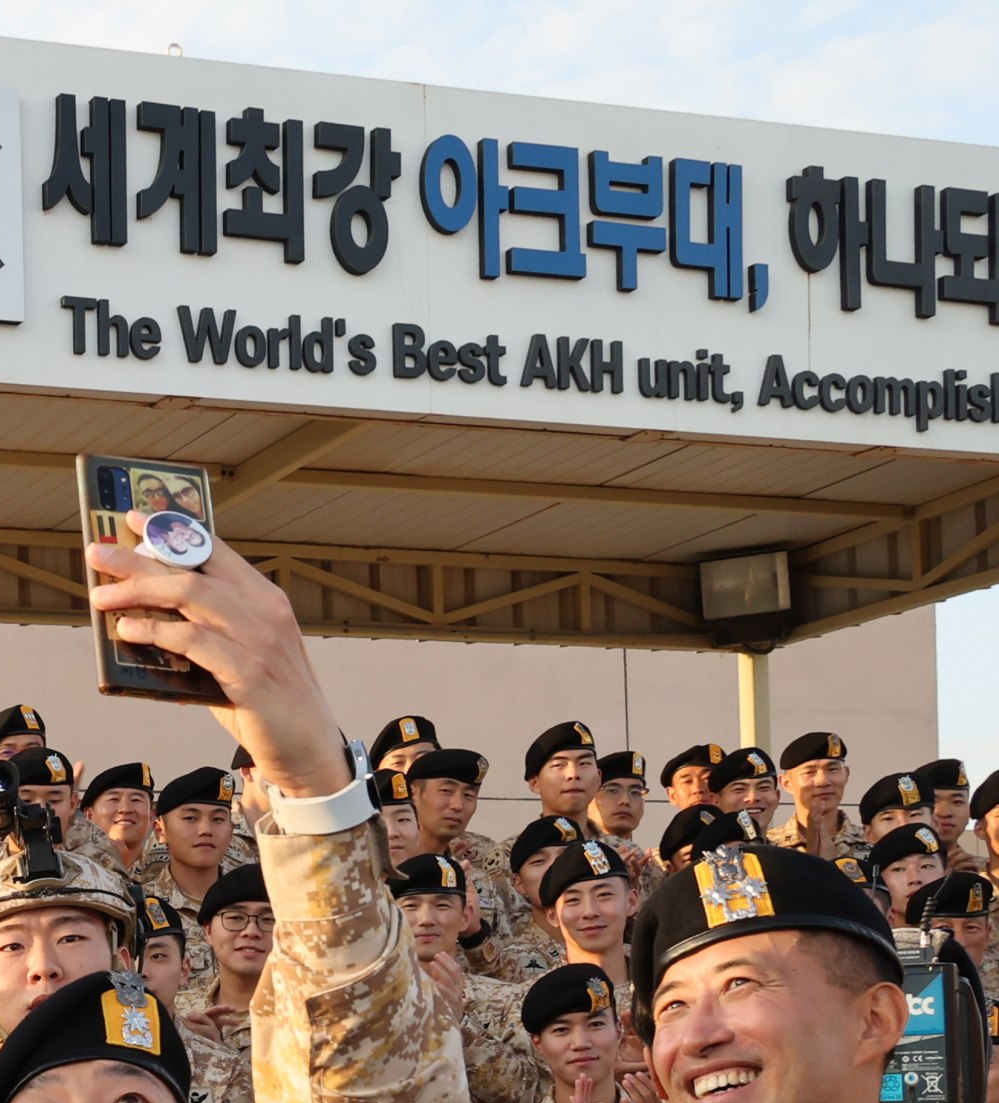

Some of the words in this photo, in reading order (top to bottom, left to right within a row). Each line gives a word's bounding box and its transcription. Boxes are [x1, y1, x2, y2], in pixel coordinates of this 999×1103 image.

[42, 93, 401, 277] 세계최강
[419, 135, 769, 313] 아크부대,
[60, 296, 162, 361] The
[177, 305, 377, 378] World's
[392, 323, 507, 388] Best
[520, 334, 624, 396] AKH
[637, 349, 744, 414] unit,
